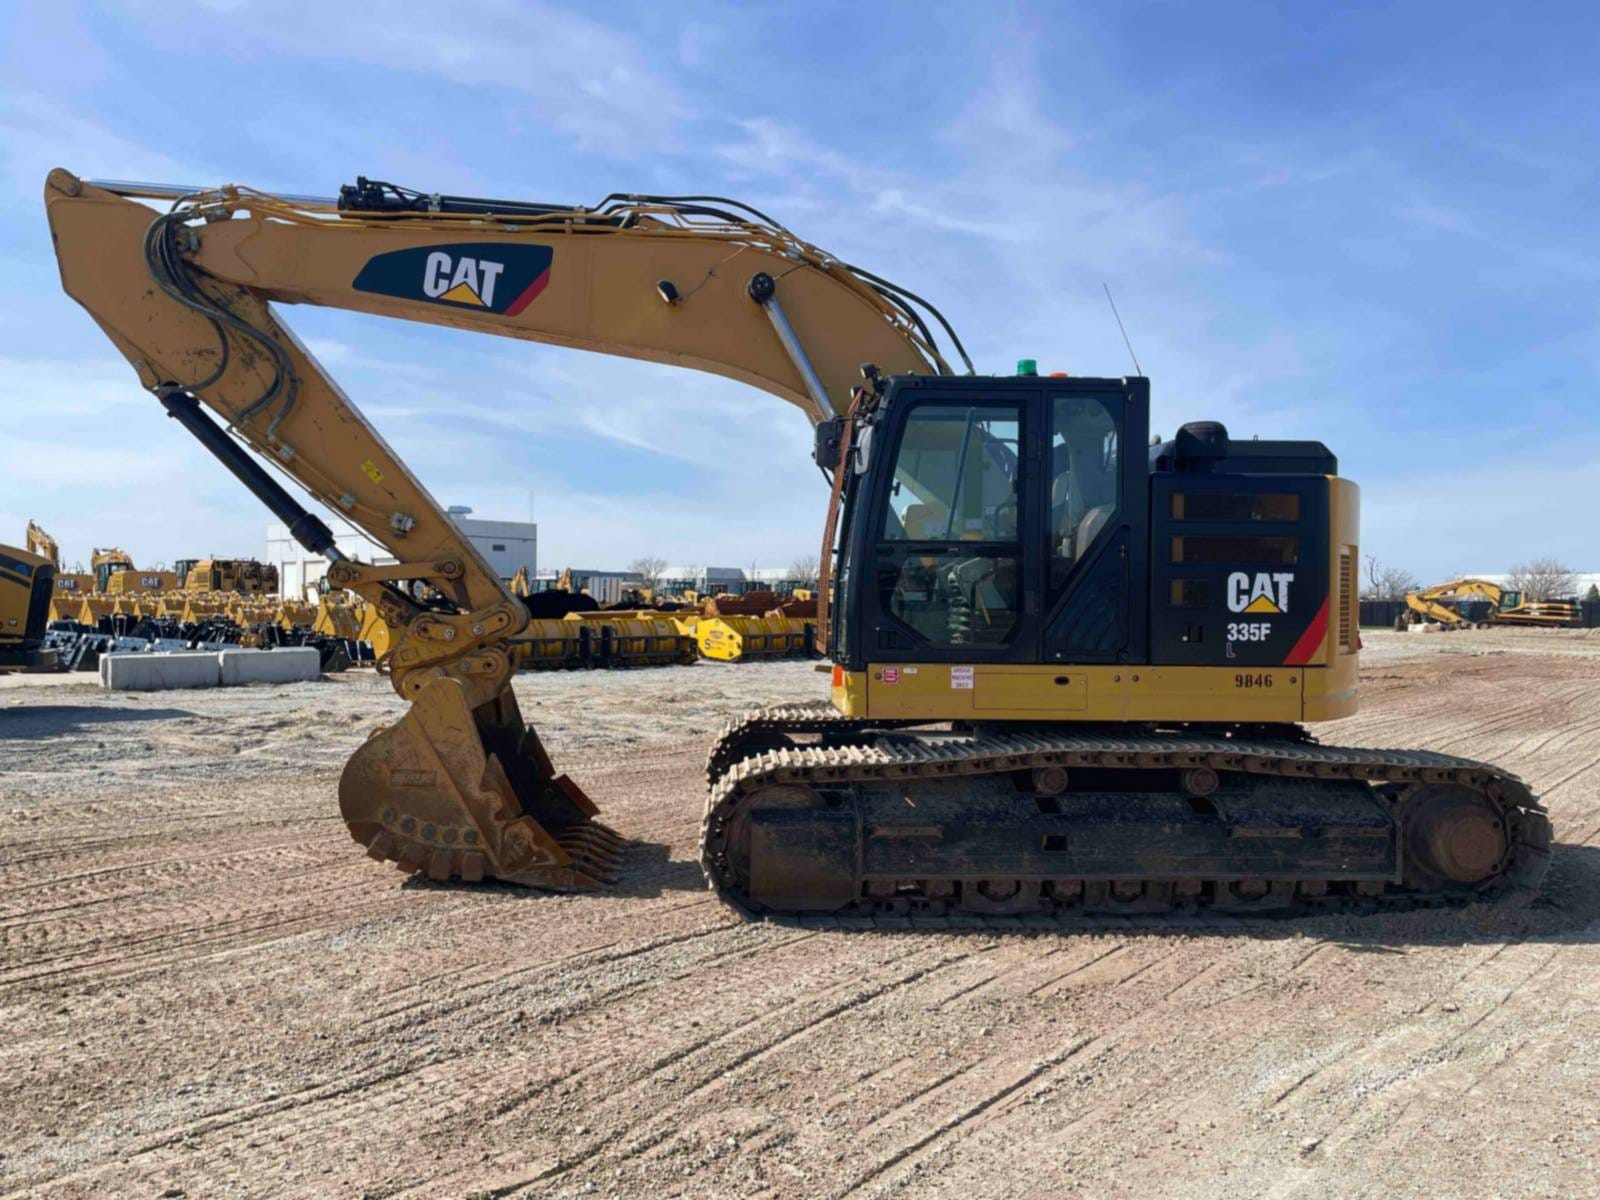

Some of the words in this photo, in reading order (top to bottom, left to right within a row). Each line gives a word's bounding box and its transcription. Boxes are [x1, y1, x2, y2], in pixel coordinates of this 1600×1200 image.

[423, 251, 504, 307] CAT
[141, 577, 158, 587] CAT
[1227, 571, 1294, 613] CAT
[1227, 623, 1271, 641] 335F
[1226, 642, 1236, 658] L
[1236, 674, 1272, 688] 9846
